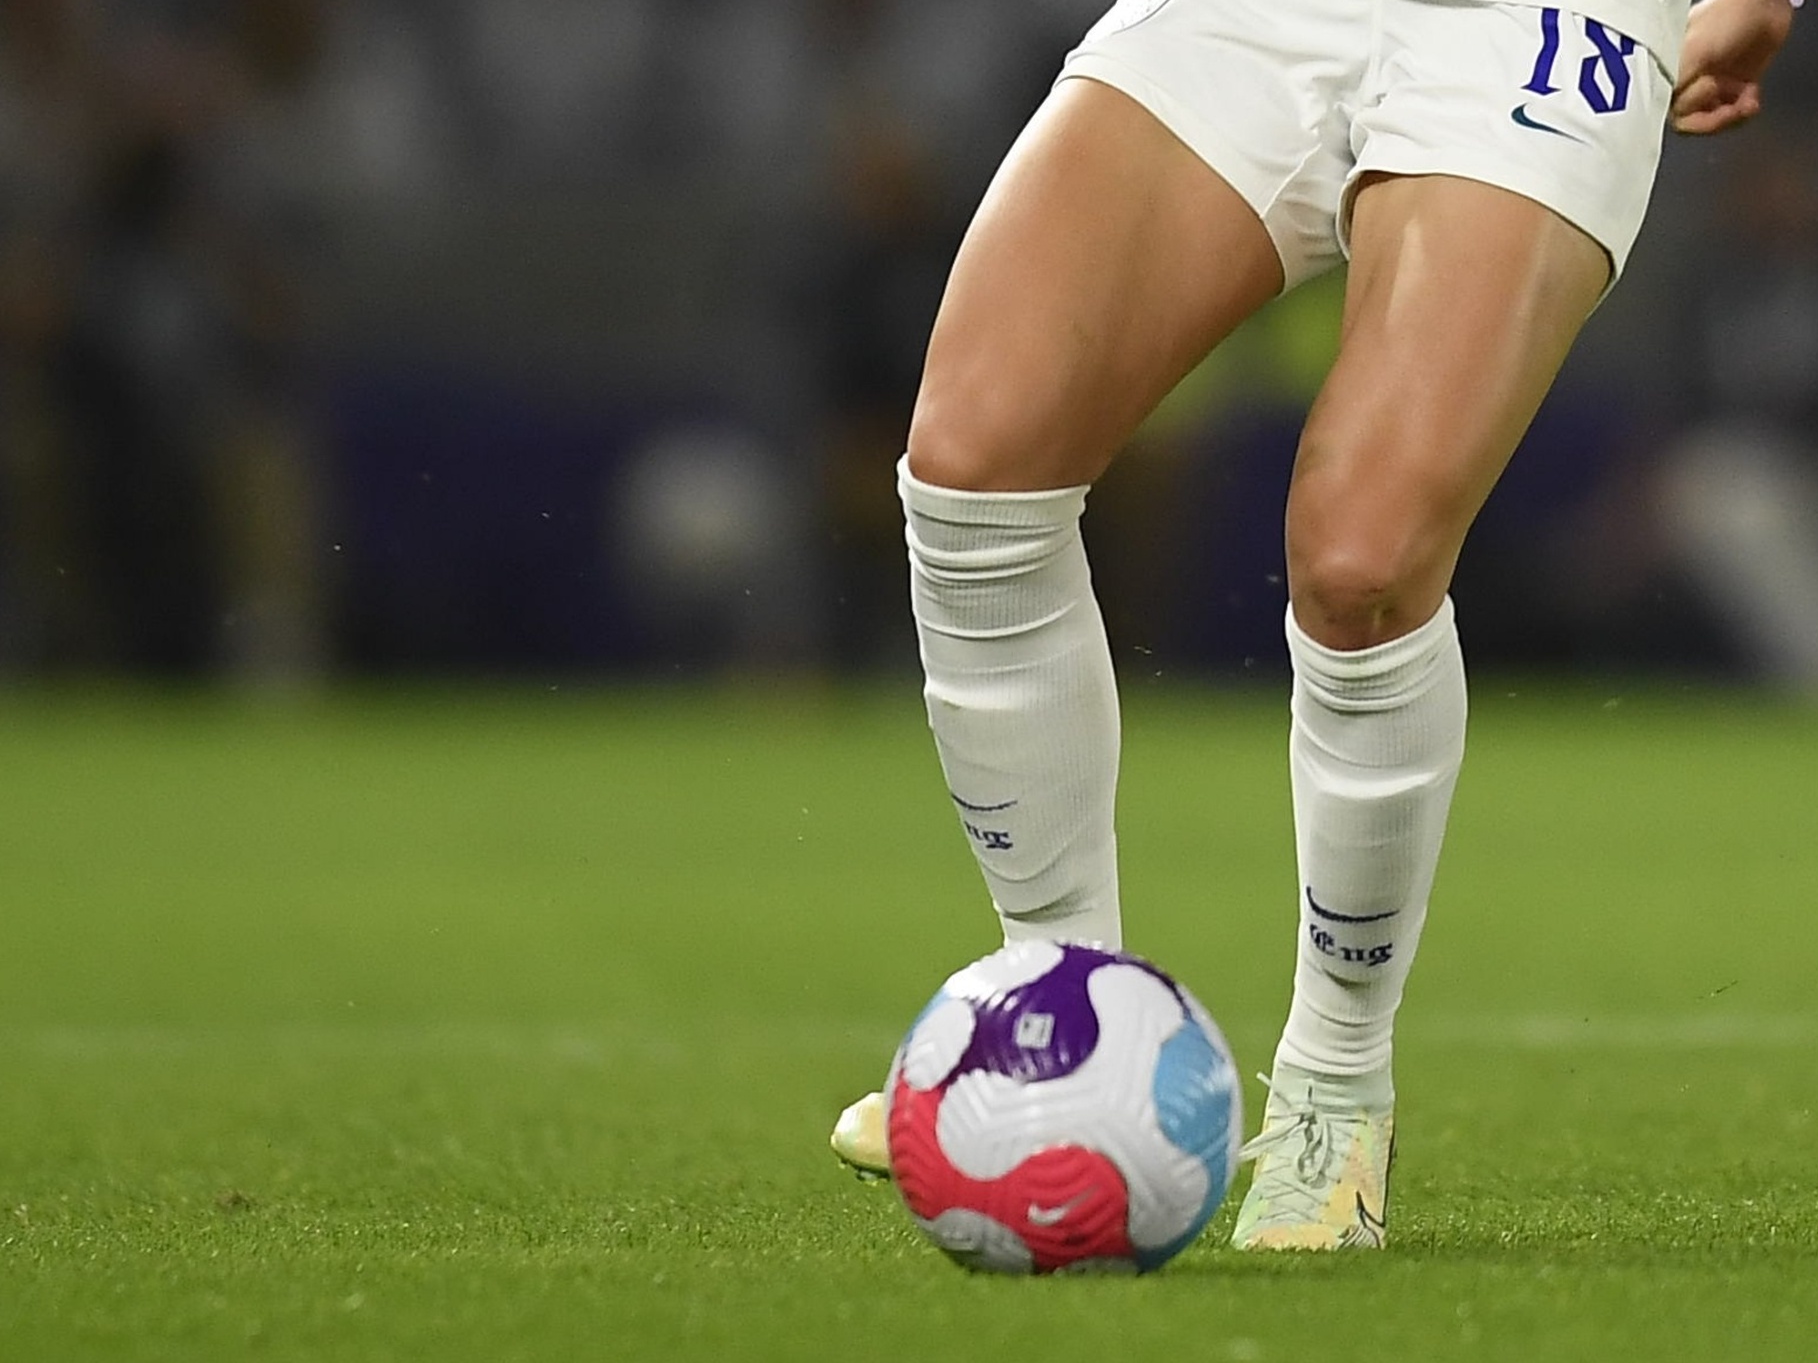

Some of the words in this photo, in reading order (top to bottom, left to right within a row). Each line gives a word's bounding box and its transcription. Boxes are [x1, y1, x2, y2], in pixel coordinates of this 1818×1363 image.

[1520, 7, 1636, 115] 18
[963, 821, 1014, 850] ng
[1309, 923, 1393, 967] Eng
